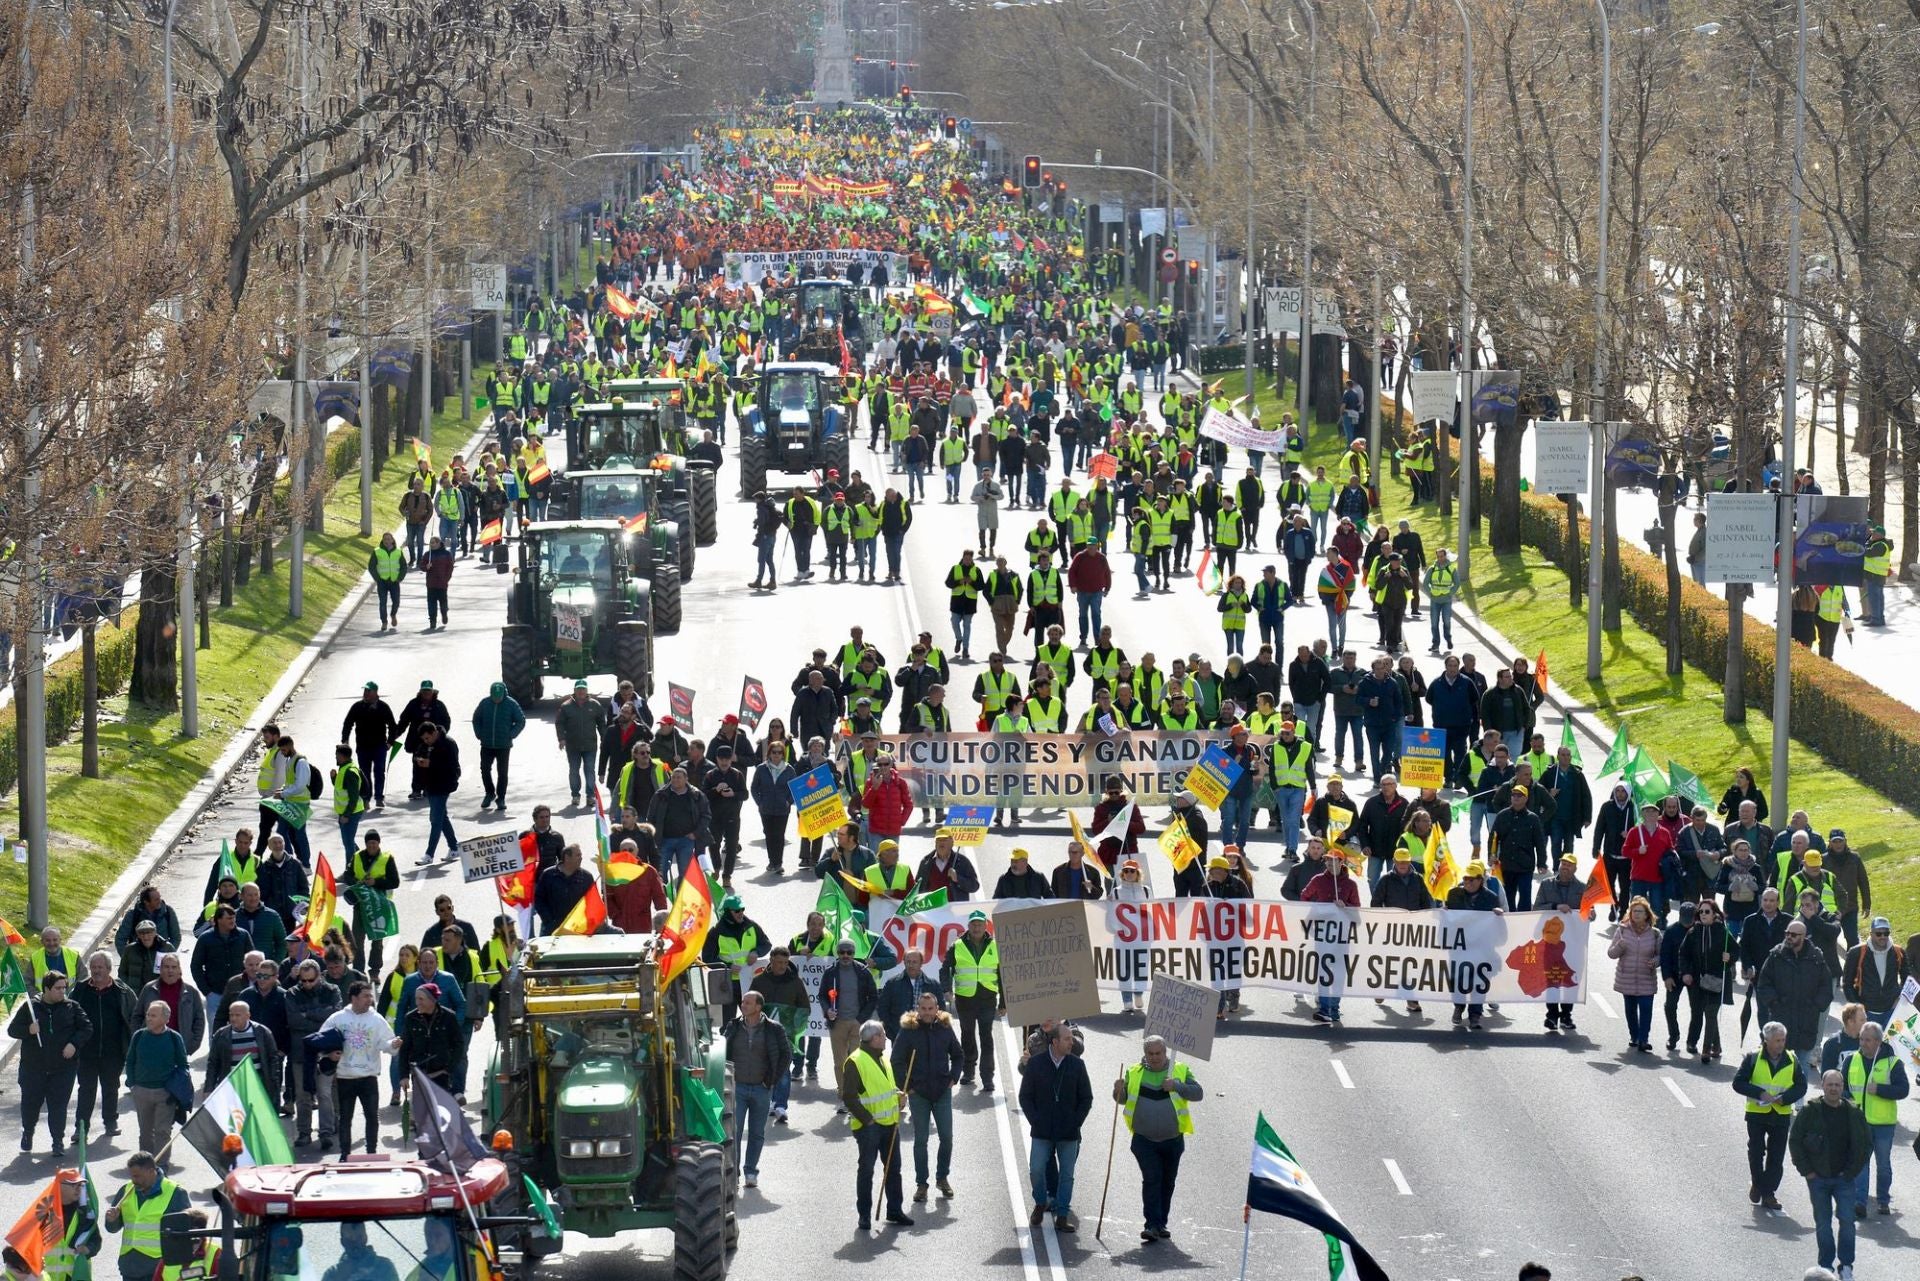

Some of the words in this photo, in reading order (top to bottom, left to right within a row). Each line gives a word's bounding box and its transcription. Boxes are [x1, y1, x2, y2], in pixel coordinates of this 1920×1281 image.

[744, 254, 766, 263] POR
[769, 254, 785, 262] UN
[788, 252, 823, 261] MEDIO
[826, 251, 863, 260] RURAL
[866, 252, 890, 261] VIVO
[487, 291, 504, 302] RA
[1267, 291, 1300, 301] MAD
[1279, 302, 1300, 313] RID
[1319, 303, 1336, 314] TU
[1538, 453, 1587, 462] QUINTANILLA
[1725, 524, 1756, 532] ISABEL
[1708, 534, 1772, 543] QUINTANILLA
[1067, 741, 1086, 763] Y
[1404, 771, 1442, 781] DESAPARECE
[801, 784, 834, 806] ABANDONO
[808, 810, 845, 832] DESAPARECE
[951, 817, 965, 825] SIN
[462, 845, 475, 853] EL
[477, 835, 514, 849] MUNDO
[473, 846, 506, 859] RURAL
[484, 855, 498, 865] SE
[469, 859, 518, 878] MUERE
[1014, 920, 1040, 939] PAC
[1115, 901, 1177, 942] SIN
[1189, 901, 1288, 942] AGUA
[1300, 919, 1358, 944] YECLA
[1366, 921, 1379, 945] Y
[1382, 922, 1467, 951] JUMILLA
[1210, 943, 1335, 987] REGADÍOS
[1344, 953, 1360, 988] Y
[1366, 954, 1492, 995] SECANOS
